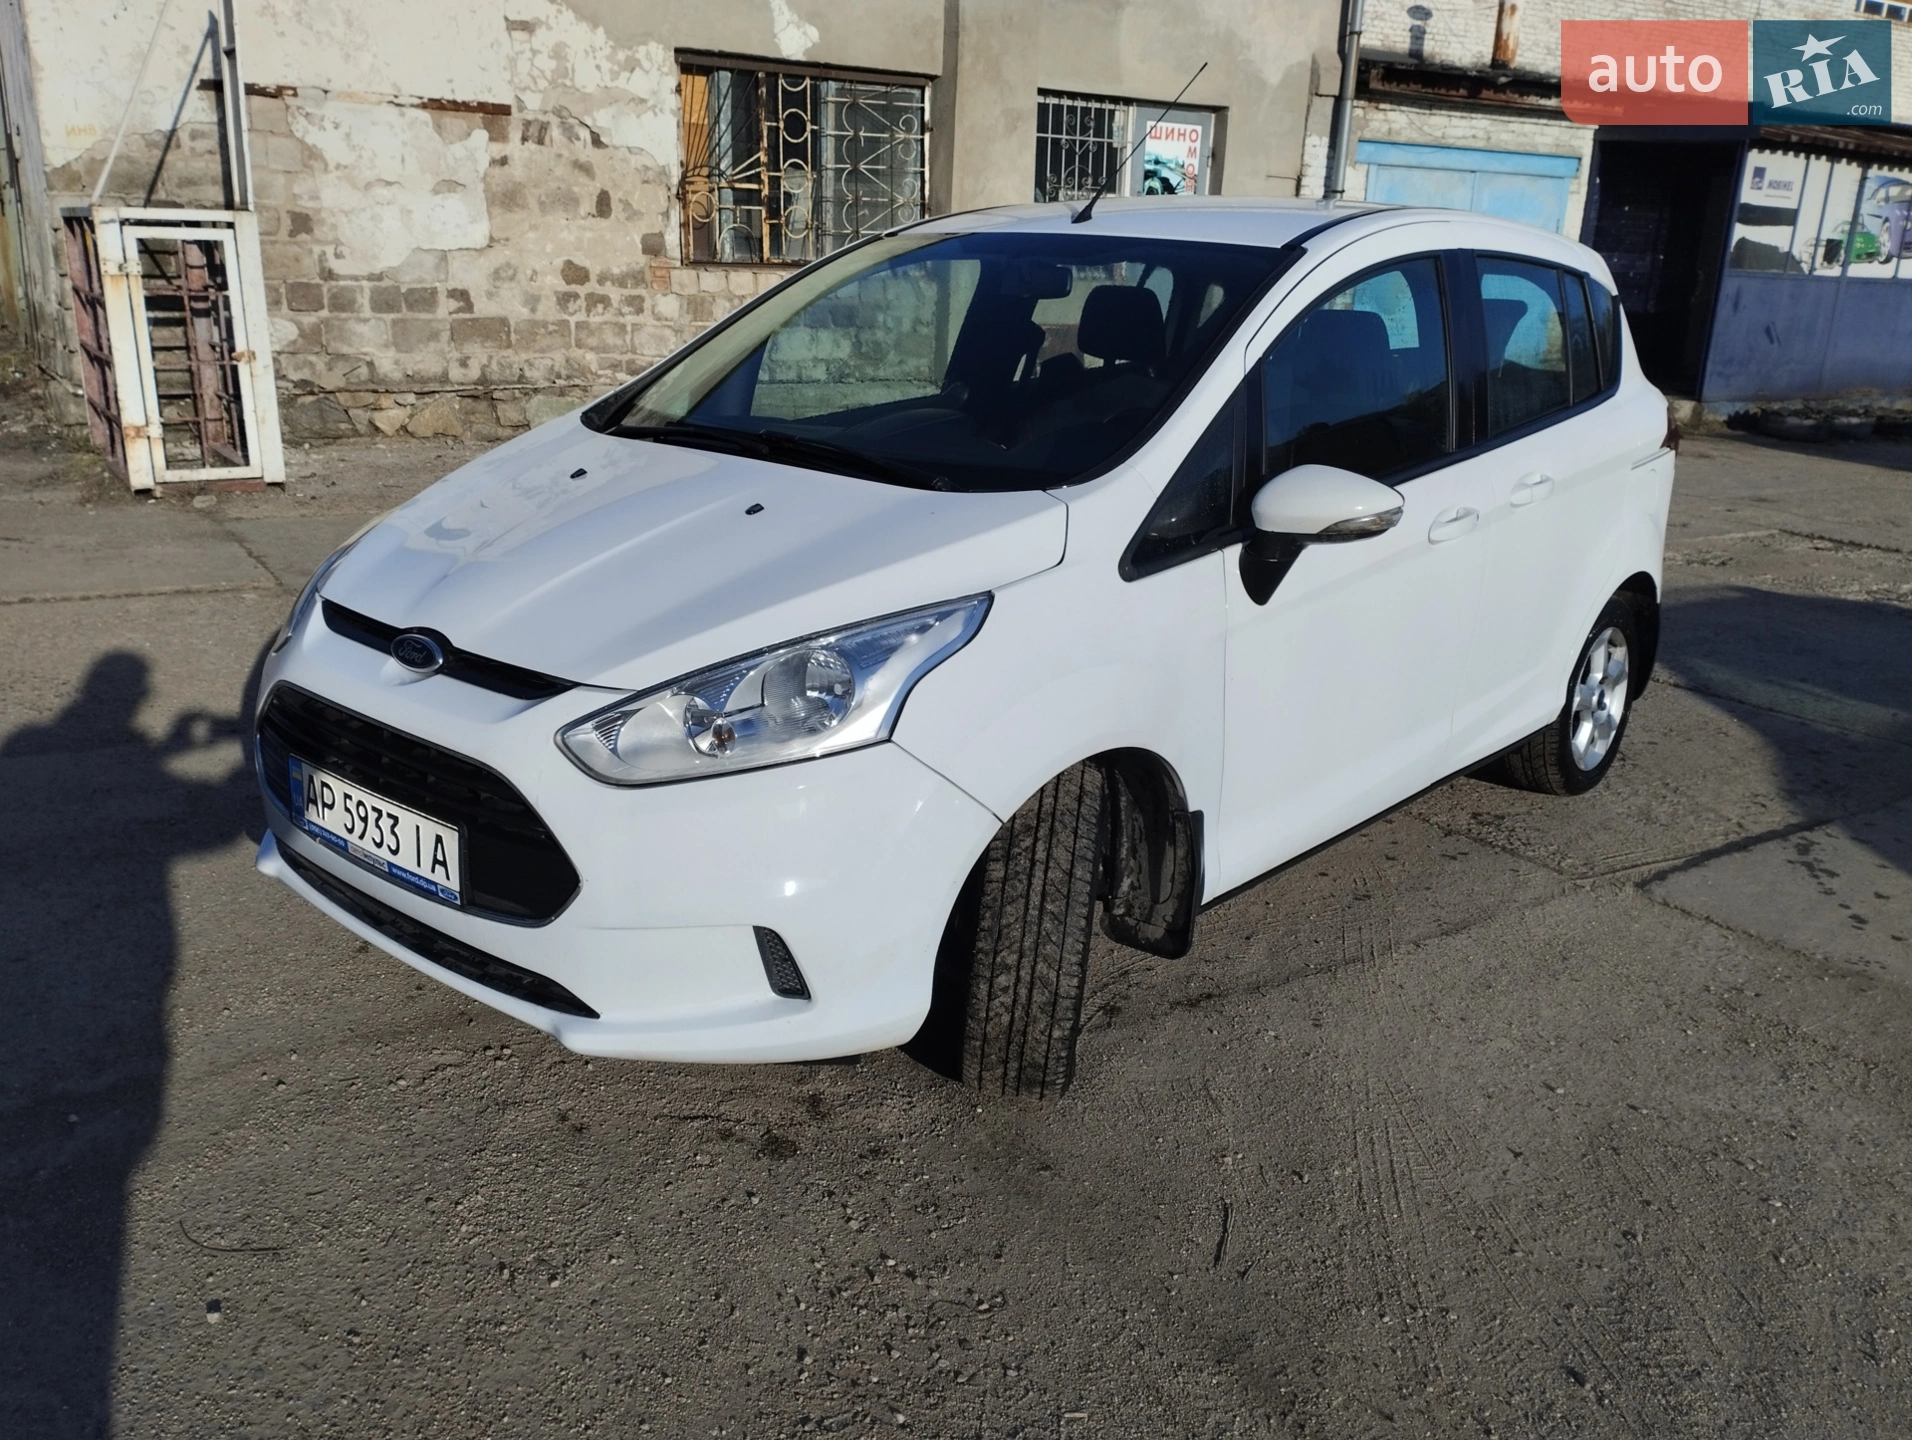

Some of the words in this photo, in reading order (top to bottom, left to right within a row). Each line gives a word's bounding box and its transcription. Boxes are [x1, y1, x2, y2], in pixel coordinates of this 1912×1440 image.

[1149, 125, 1199, 143] ШИНО
[398, 640, 427, 663] Ford
[306, 774, 336, 822] AP
[343, 792, 401, 856] 5933
